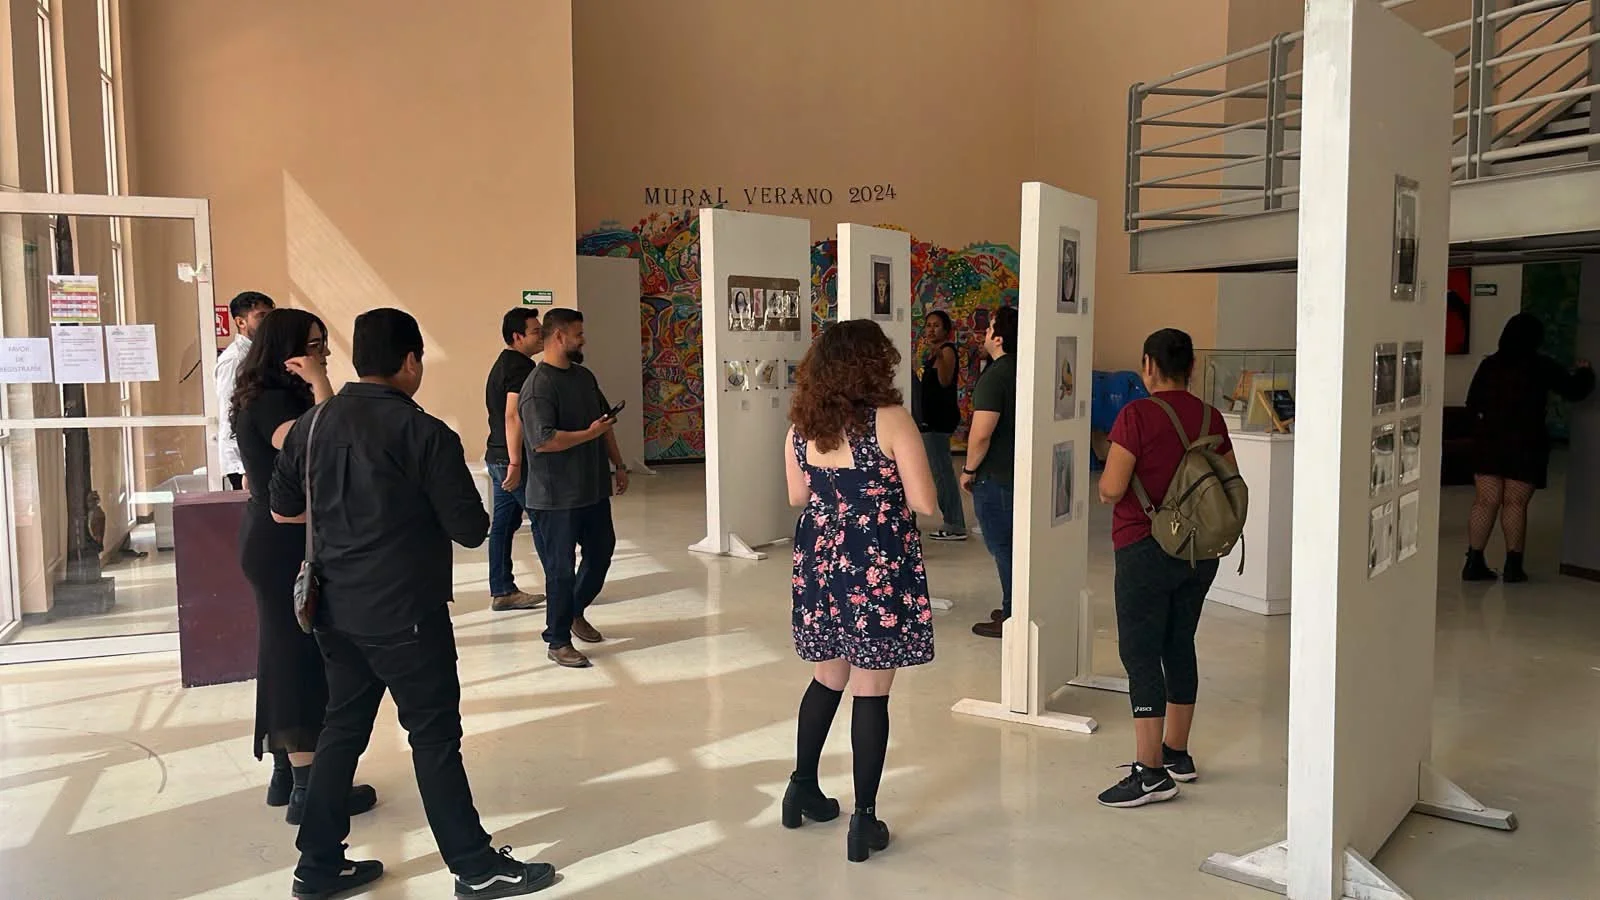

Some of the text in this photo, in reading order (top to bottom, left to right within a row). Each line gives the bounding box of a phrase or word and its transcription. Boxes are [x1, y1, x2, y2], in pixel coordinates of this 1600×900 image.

[645, 184, 896, 207] MURAL VERANO 2024
